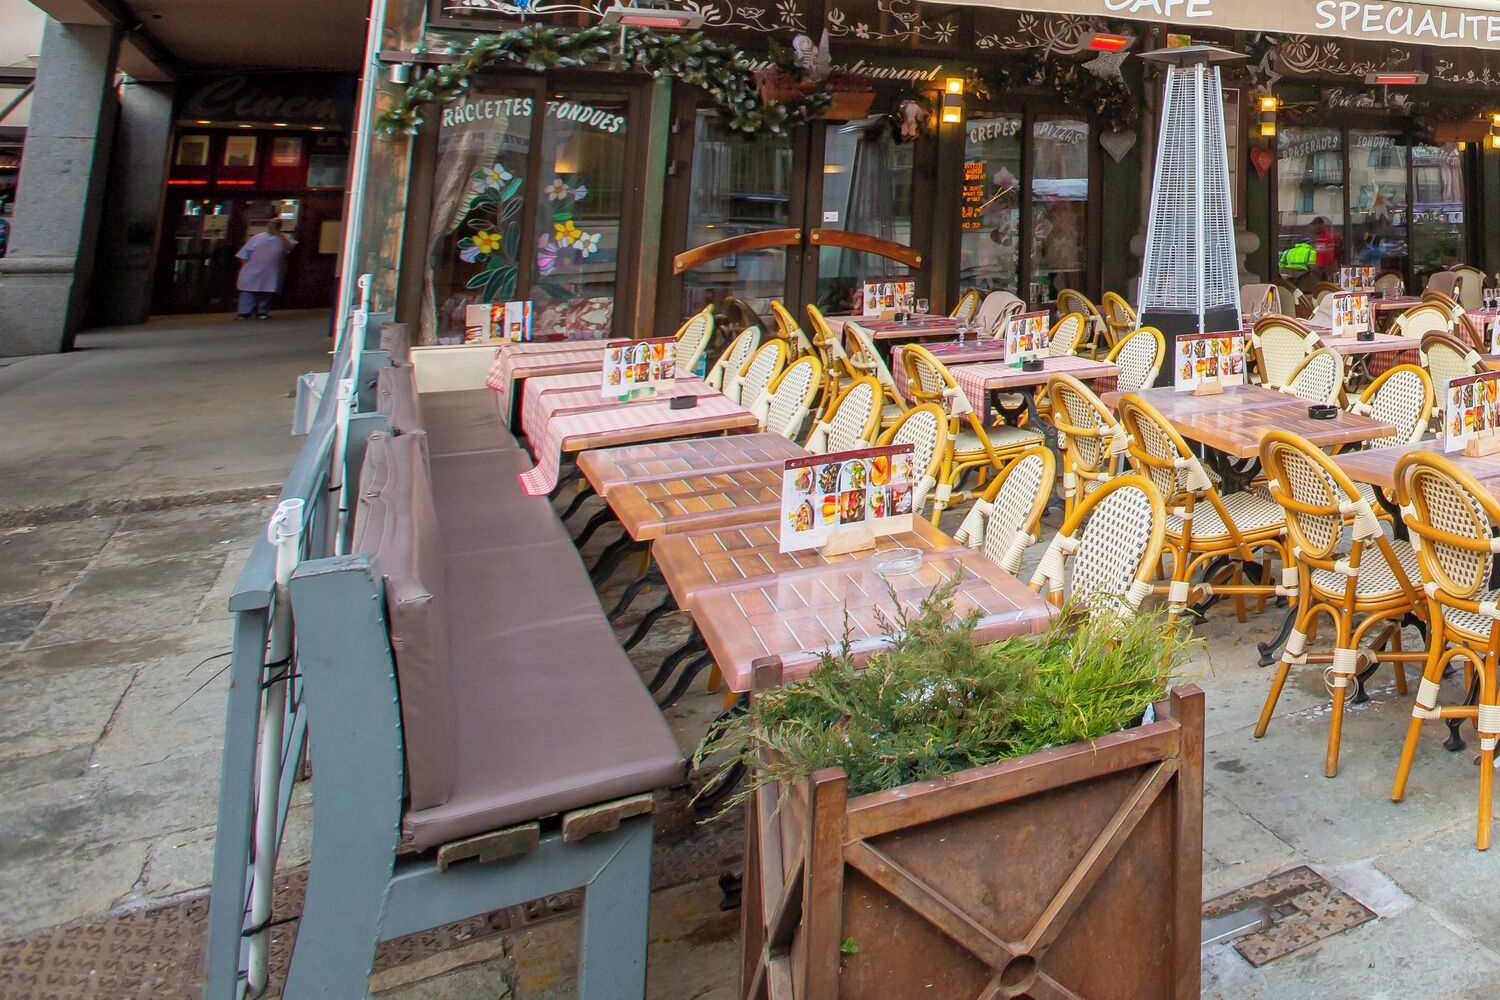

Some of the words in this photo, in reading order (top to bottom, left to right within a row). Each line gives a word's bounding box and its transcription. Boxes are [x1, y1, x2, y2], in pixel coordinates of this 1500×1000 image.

[443, 97, 533, 128] RACLETTES
[546, 101, 625, 133] FONDUES
[970, 121, 1018, 144] CREPES
[1039, 123, 1082, 145] PIZZAS
